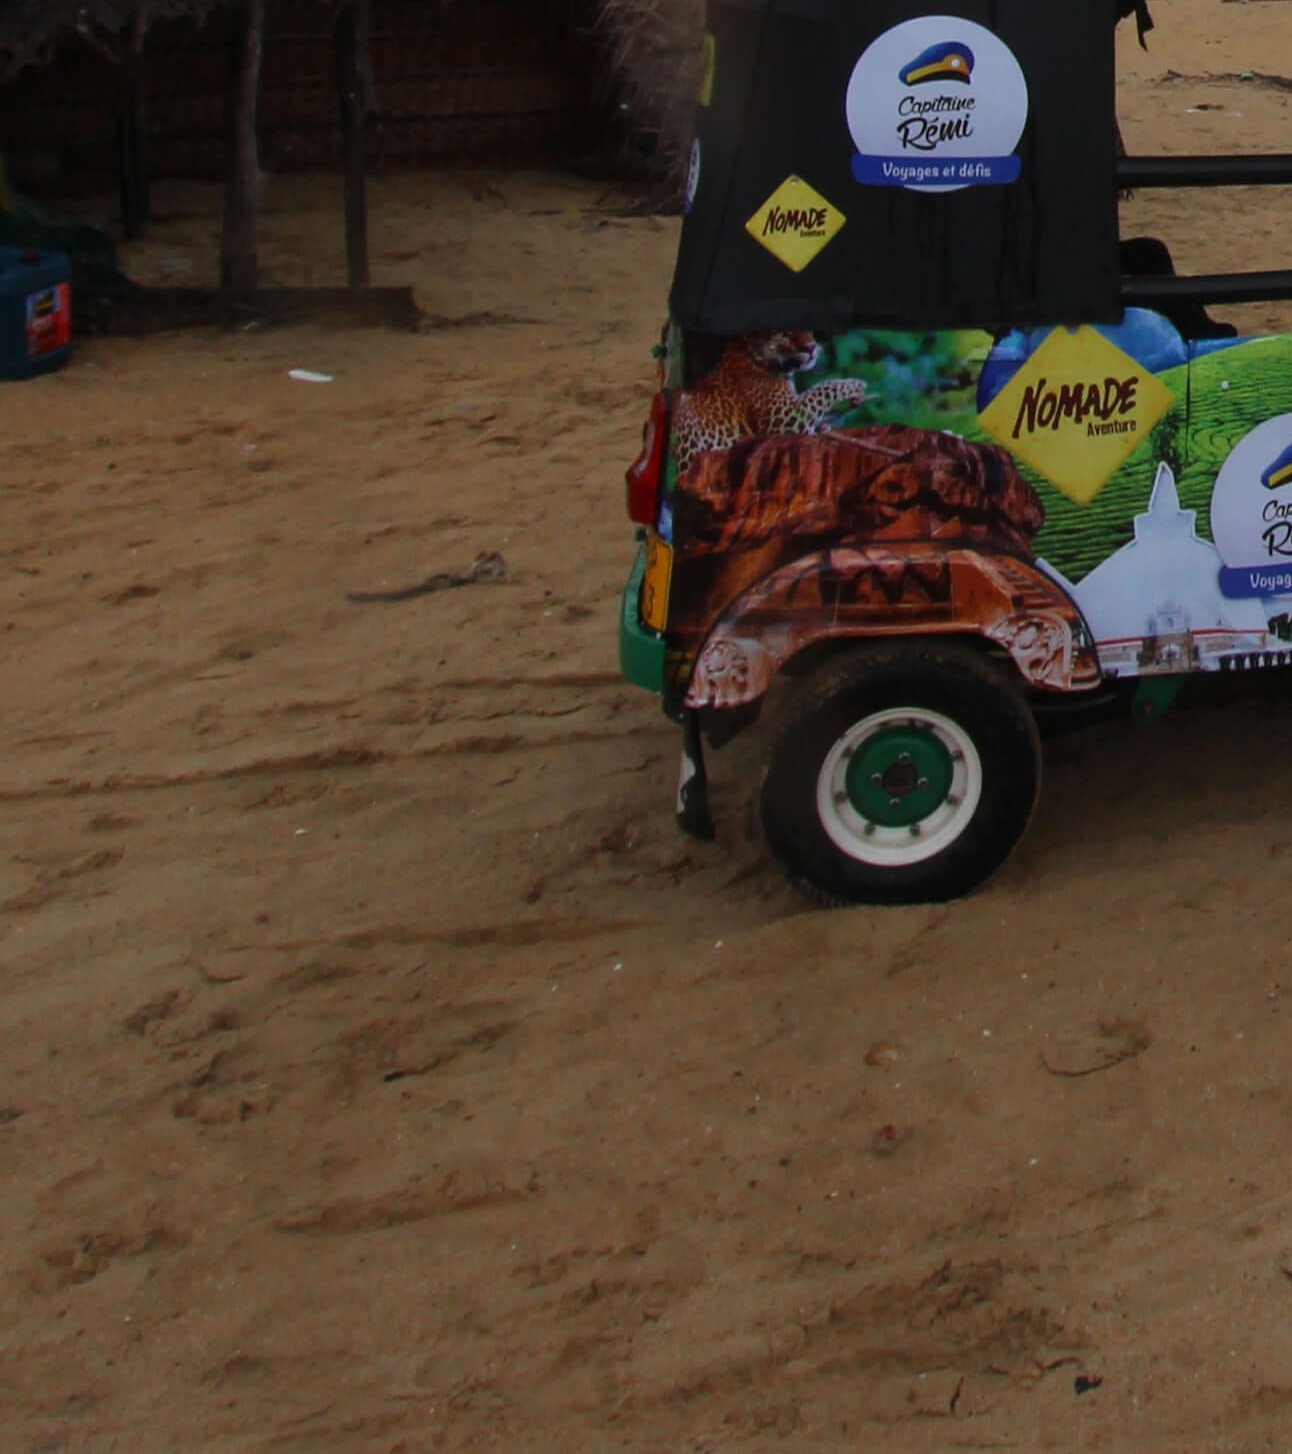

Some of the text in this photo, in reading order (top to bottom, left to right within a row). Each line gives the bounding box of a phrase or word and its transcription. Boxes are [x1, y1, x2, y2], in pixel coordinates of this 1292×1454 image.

[898, 95, 976, 116] Capitaine
[896, 113, 974, 151] Rémi
[883, 162, 992, 181] Voyages et défis
[1011, 376, 1139, 439] NOMADE
[1087, 420, 1137, 437] Aventure
